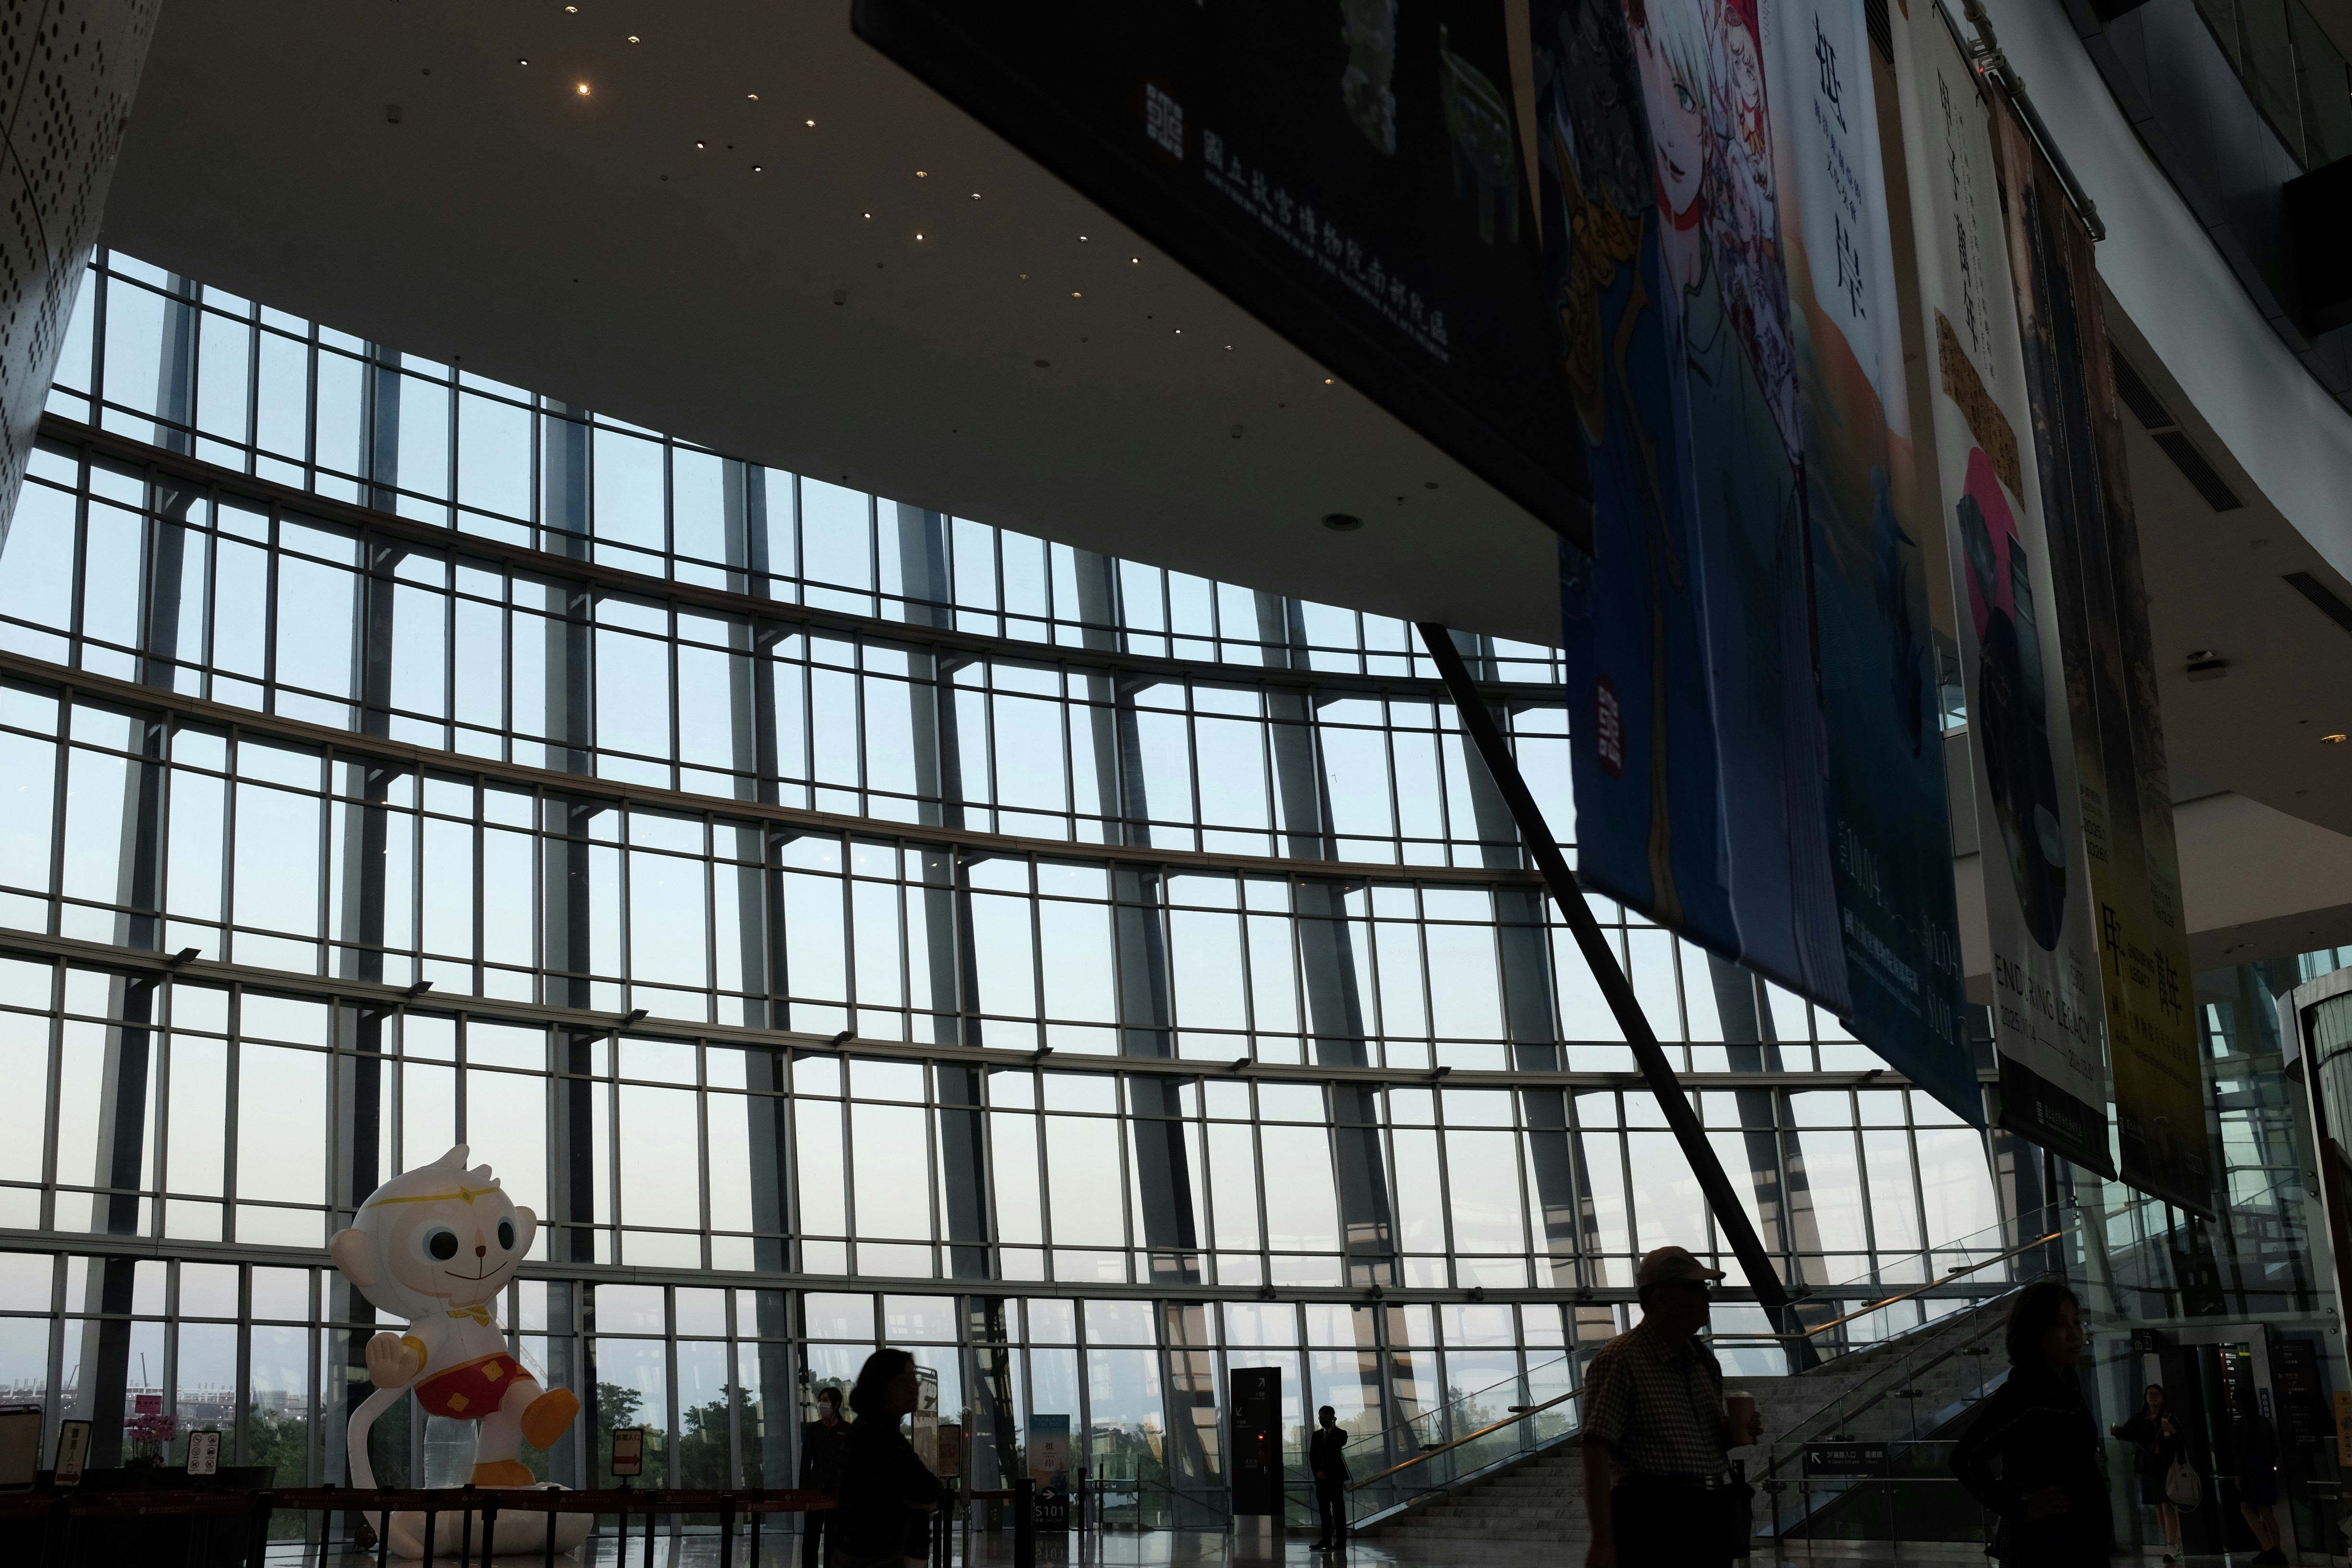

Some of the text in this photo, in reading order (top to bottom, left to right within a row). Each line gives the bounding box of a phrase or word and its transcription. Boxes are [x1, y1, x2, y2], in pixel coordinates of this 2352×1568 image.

[1995, 953, 2091, 1047] ENDURING LEGACY
[616, 1433, 640, 1442] 售票入口
[1035, 1506, 1064, 1517] S101
